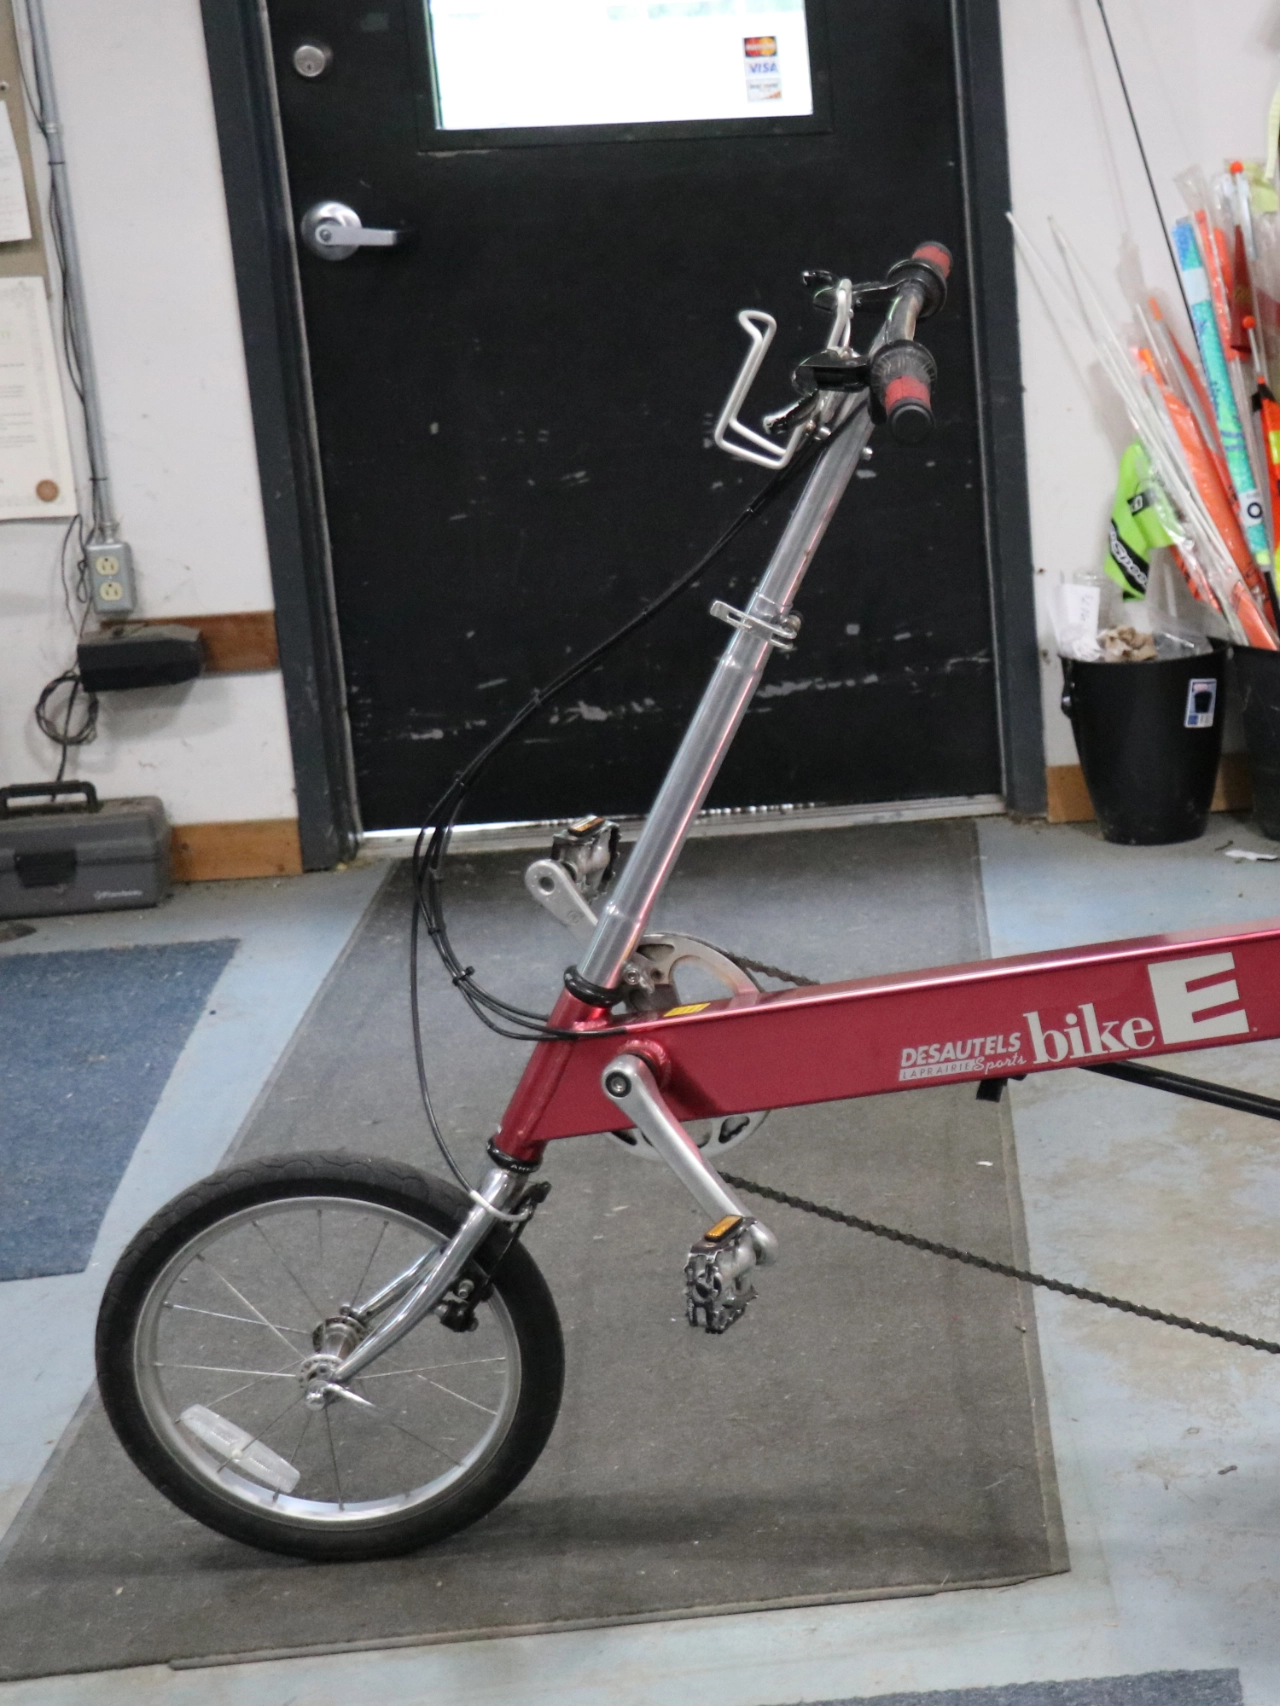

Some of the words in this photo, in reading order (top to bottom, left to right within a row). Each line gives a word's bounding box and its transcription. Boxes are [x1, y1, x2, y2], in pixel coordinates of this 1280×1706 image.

[749, 62, 779, 74] VISA
[900, 1032, 1021, 1067] DESAUTELS
[902, 1061, 972, 1080] LAPRAIRIE
[973, 1052, 1027, 1075] Sports
